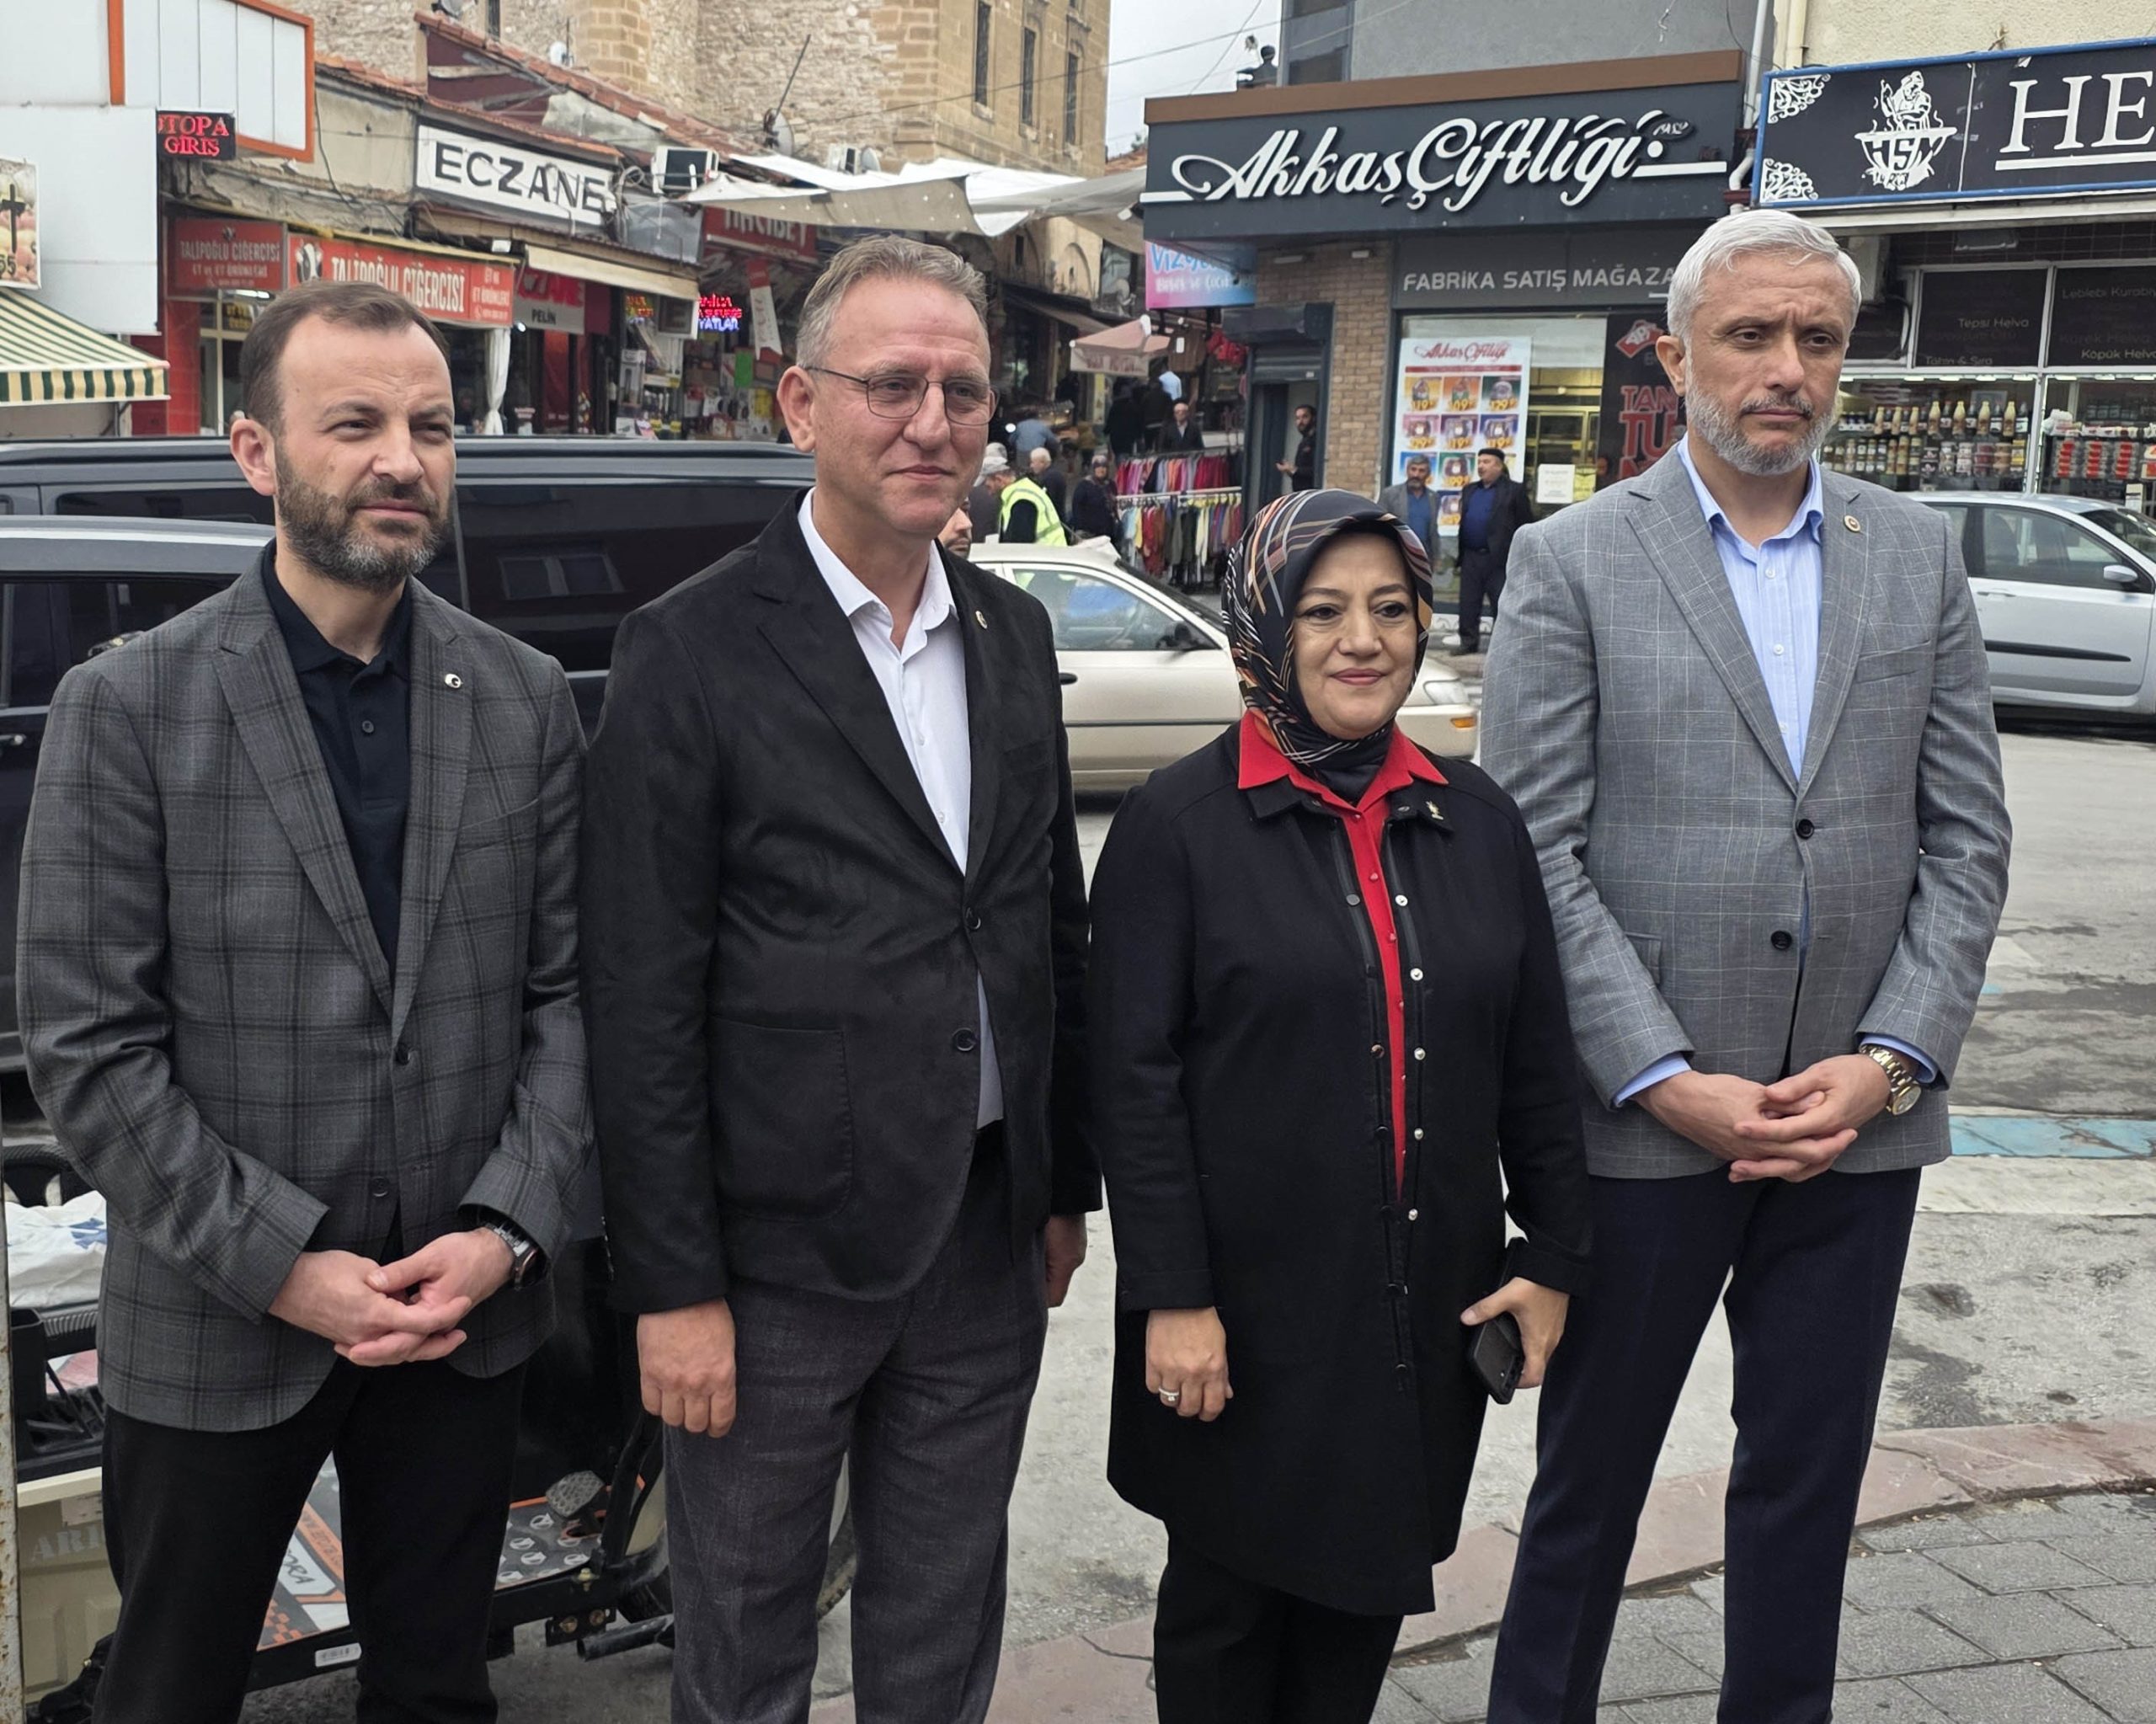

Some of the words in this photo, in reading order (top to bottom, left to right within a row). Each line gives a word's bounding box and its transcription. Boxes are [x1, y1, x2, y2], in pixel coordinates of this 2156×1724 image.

[435, 141, 606, 212] ECZANE
[1403, 271, 1495, 291] FABRİKA
[1502, 269, 1566, 291] SATIŞ
[531, 308, 557, 325] PELİN
[1993, 317, 2030, 328] Helva
